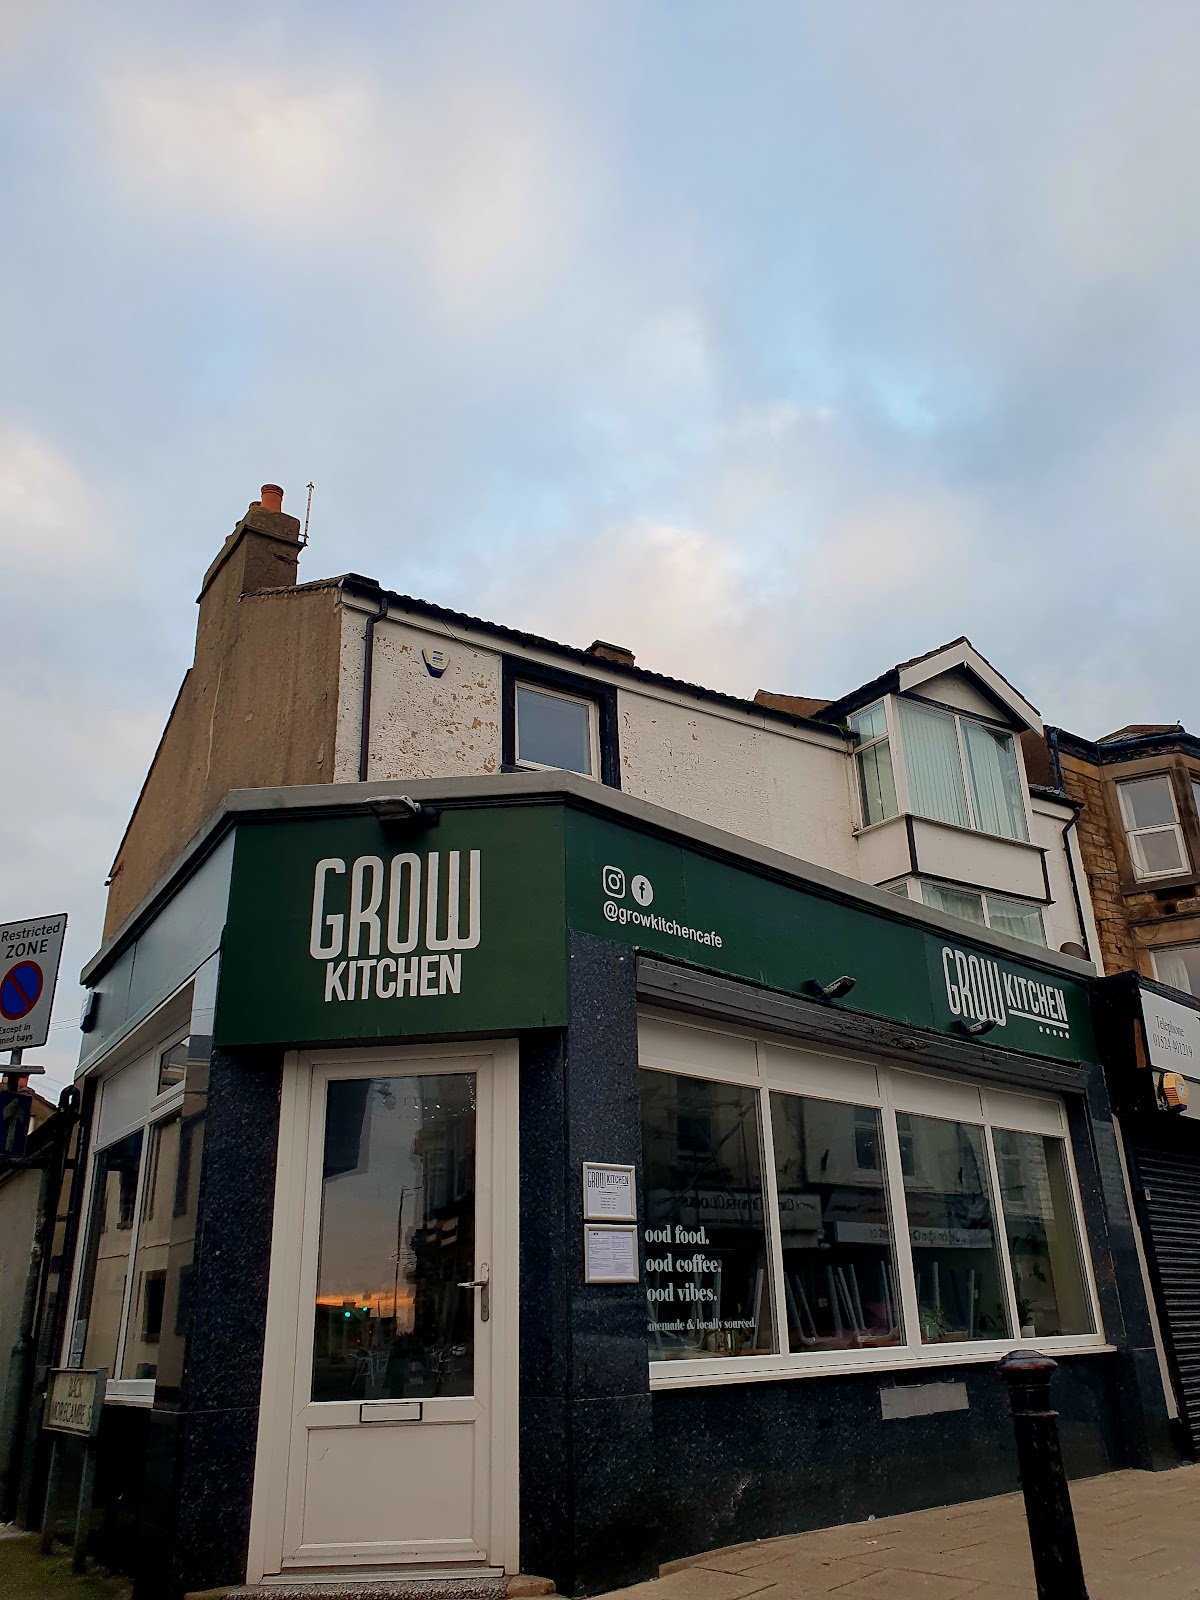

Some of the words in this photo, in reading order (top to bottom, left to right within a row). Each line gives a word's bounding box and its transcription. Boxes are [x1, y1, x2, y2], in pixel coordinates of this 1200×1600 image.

[310, 850, 480, 960] GROW
[1, 921, 61, 943] Restricted
[603, 900, 723, 948] @growkitchencafe
[5, 939, 49, 959] ZONE
[325, 953, 462, 1002] KITCHEN
[941, 946, 1007, 1027] GROW
[1002, 972, 1068, 1022] KITCHEN
[24, 1023, 31, 1031] in
[1155, 1015, 1185, 1038] Telephone
[16, 1034, 34, 1043] bays
[1152, 1032, 1172, 1052] 01524
[587, 1171, 606, 1189] GROW
[606, 1174, 629, 1185] KITCHEN
[644, 1224, 672, 1243] ood
[674, 1224, 710, 1245] food.
[645, 1253, 673, 1272] ood
[675, 1253, 722, 1273] coffee.
[646, 1282, 675, 1302] ood
[676, 1282, 718, 1302] vibes.
[648, 1319, 685, 1332] memade
[686, 1318, 696, 1331] &
[696, 1317, 722, 1332] locally
